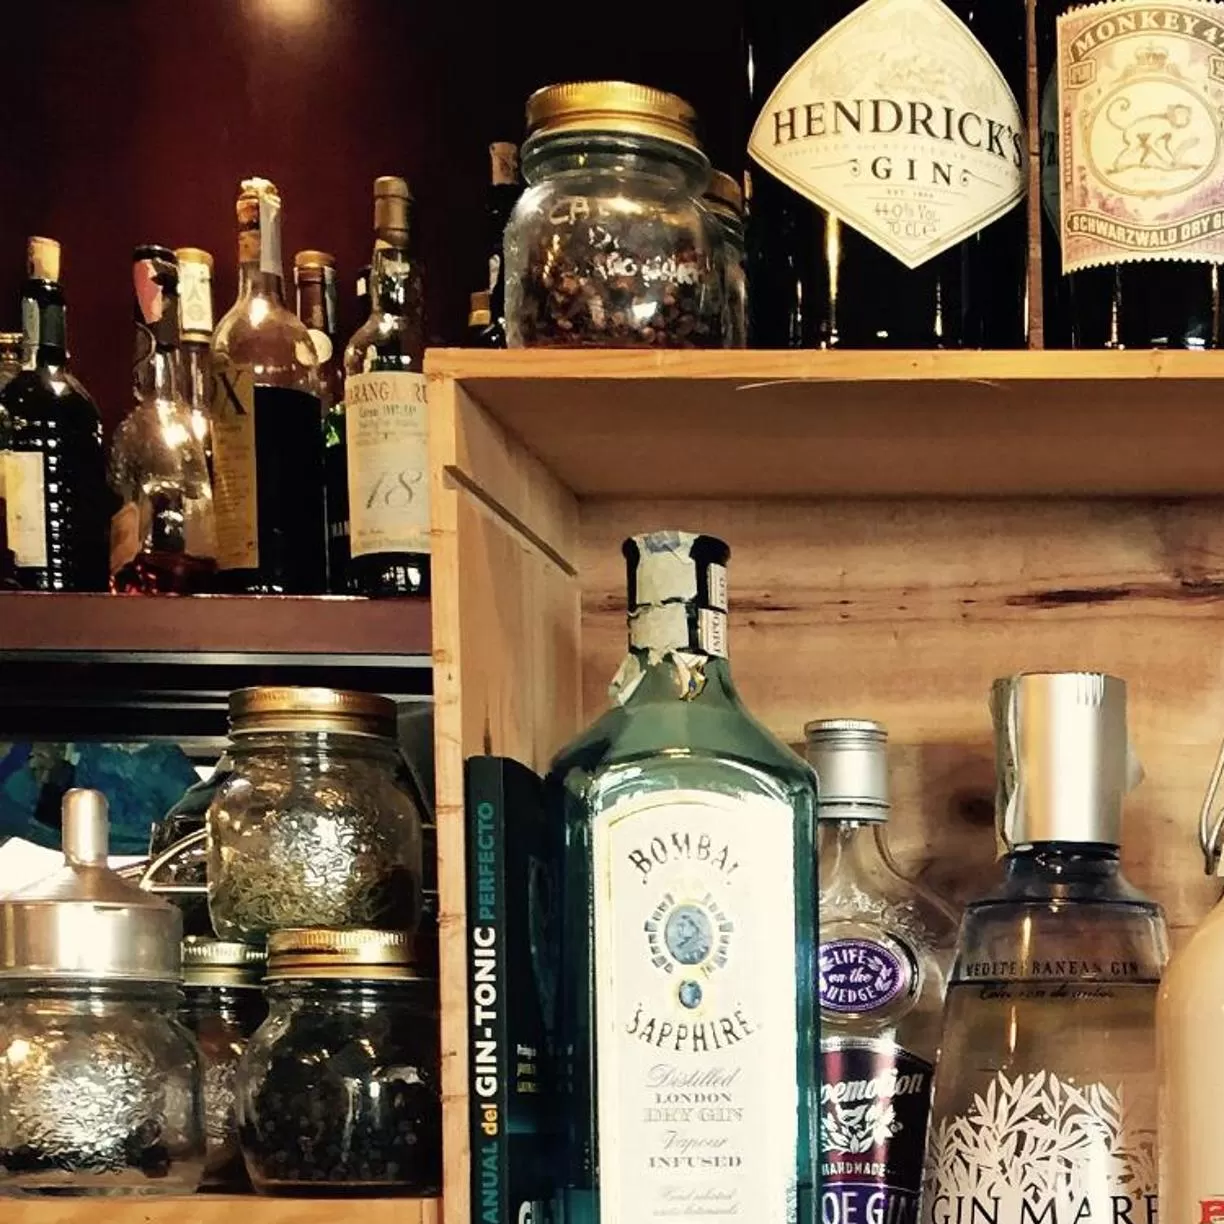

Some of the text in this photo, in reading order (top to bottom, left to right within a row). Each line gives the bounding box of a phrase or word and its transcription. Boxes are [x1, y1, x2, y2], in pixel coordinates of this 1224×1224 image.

[1075, 11, 1200, 56] MONKEY
[772, 99, 1023, 169] HENDRICK'S
[871, 155, 953, 186] GIN
[1072, 214, 1178, 247] SCHWARZWALD
[1180, 216, 1211, 238] DRY
[477, 802, 495, 921] PERFECTO
[833, 949, 870, 965] LIFE
[1110, 961, 1139, 976] GIN
[828, 967, 874, 984] on the
[826, 985, 877, 1002] HEDGE
[474, 926, 498, 1098] GIN-TONIC
[625, 1005, 759, 1053] SAPPHIRE
[645, 1063, 742, 1088] Distilled
[655, 1092, 732, 1104] LONDON
[480, 1103, 498, 1136] del
[643, 1107, 745, 1122] DRY GIN
[661, 1130, 729, 1156] Vapour
[649, 1156, 742, 1168] INFUSED
